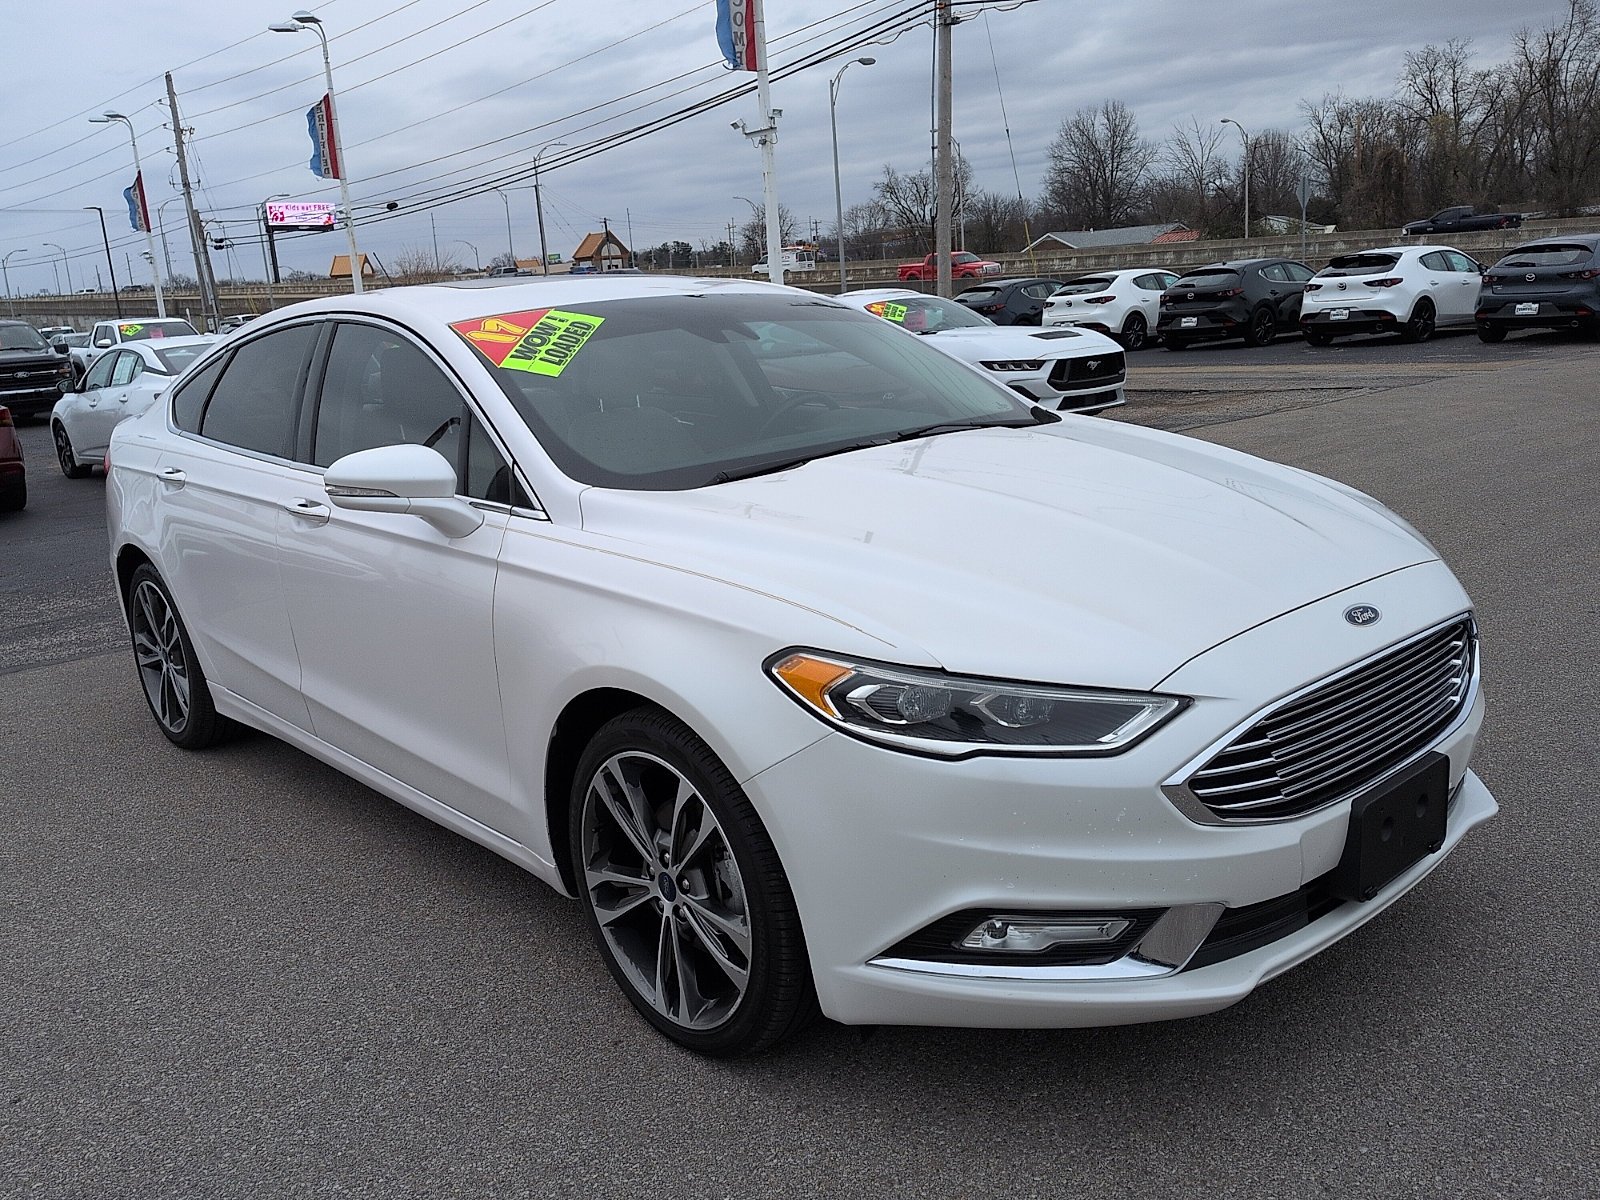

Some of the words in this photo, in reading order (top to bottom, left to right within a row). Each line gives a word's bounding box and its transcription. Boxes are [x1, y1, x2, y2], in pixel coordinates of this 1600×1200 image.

[465, 318, 528, 344] 17
[539, 320, 596, 367] LOADED
[1351, 608, 1375, 623] Ford
